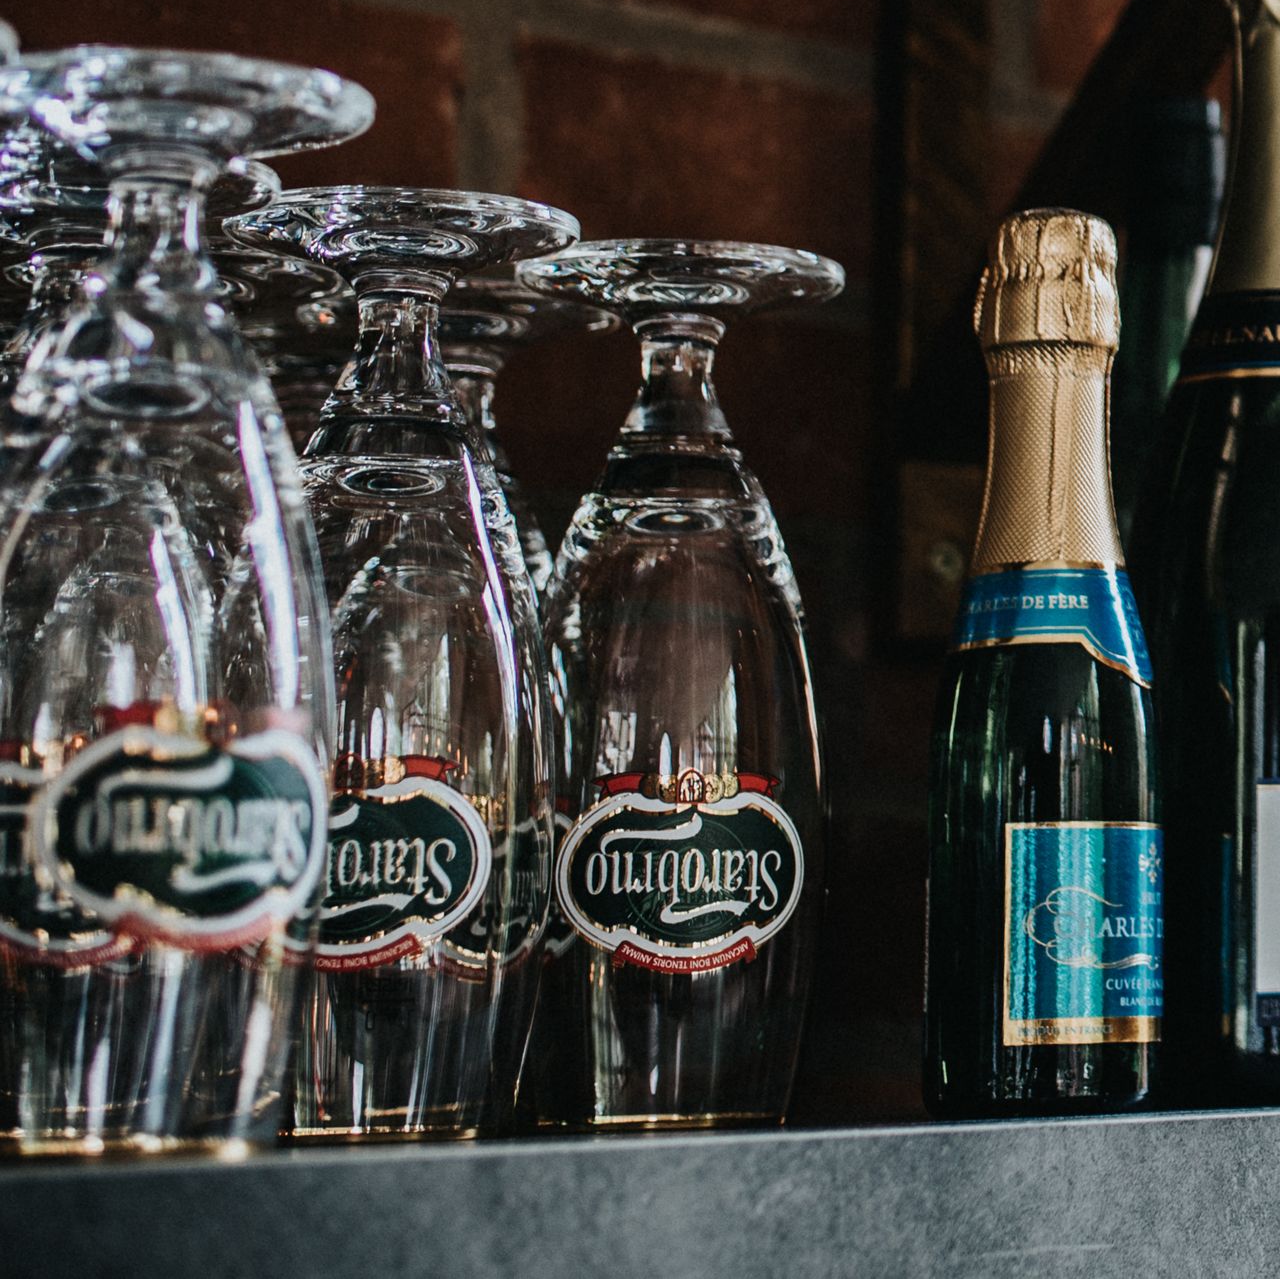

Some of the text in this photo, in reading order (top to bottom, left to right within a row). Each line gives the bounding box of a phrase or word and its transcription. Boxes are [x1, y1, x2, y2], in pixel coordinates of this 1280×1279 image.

[1021, 595, 1045, 610] DE
[1048, 591, 1089, 610] FÈRE
[587, 817, 782, 923] Starobrno
[620, 941, 749, 969] ARCANUM BONI TENORIS ANIMAE
